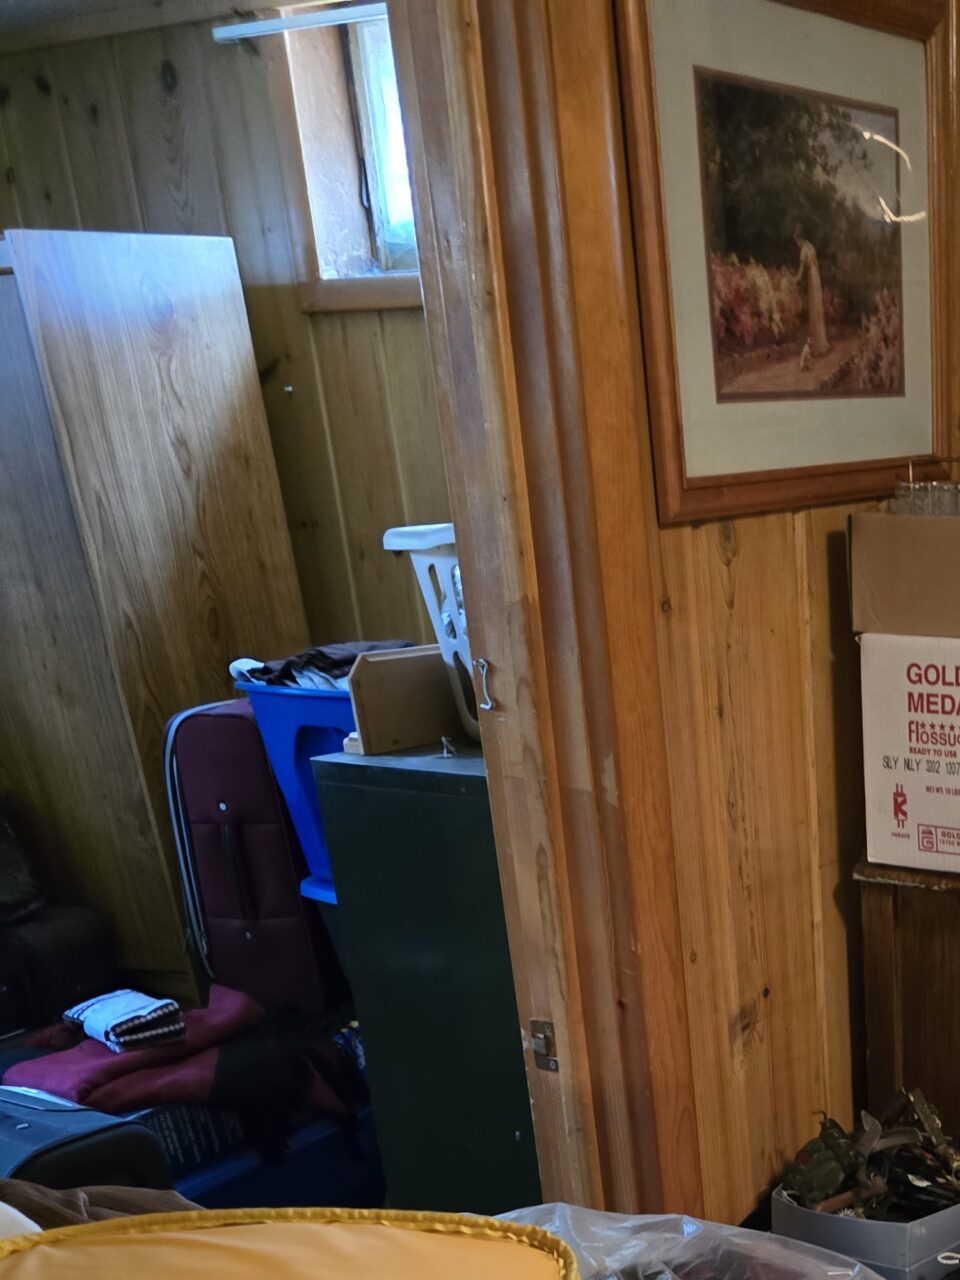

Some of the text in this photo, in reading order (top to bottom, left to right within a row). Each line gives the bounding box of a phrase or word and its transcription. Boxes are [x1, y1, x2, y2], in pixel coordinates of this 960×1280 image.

[909, 747, 957, 758] READY TO USE
